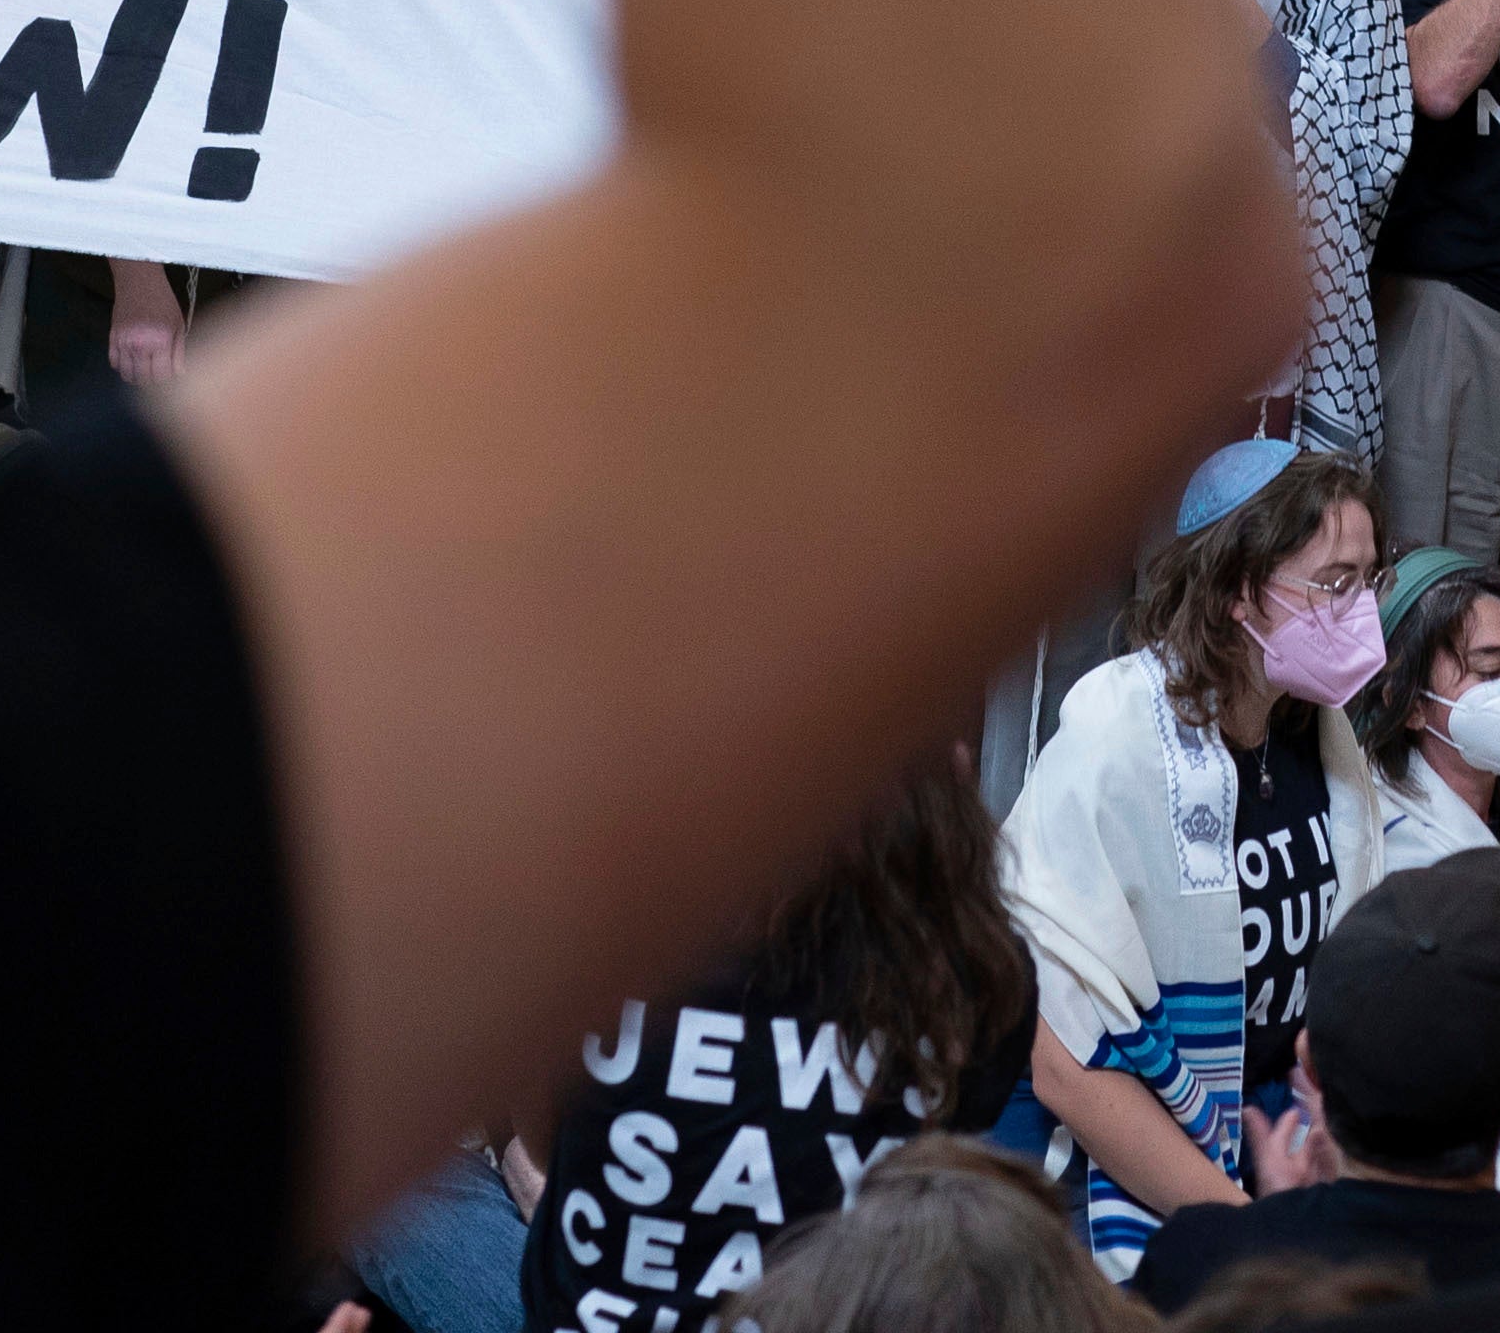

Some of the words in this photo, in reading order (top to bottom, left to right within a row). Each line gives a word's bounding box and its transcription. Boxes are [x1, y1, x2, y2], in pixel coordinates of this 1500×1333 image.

[1236, 827, 1295, 890] OT
[1307, 810, 1331, 866] I
[561, 1188, 764, 1299] CEA
